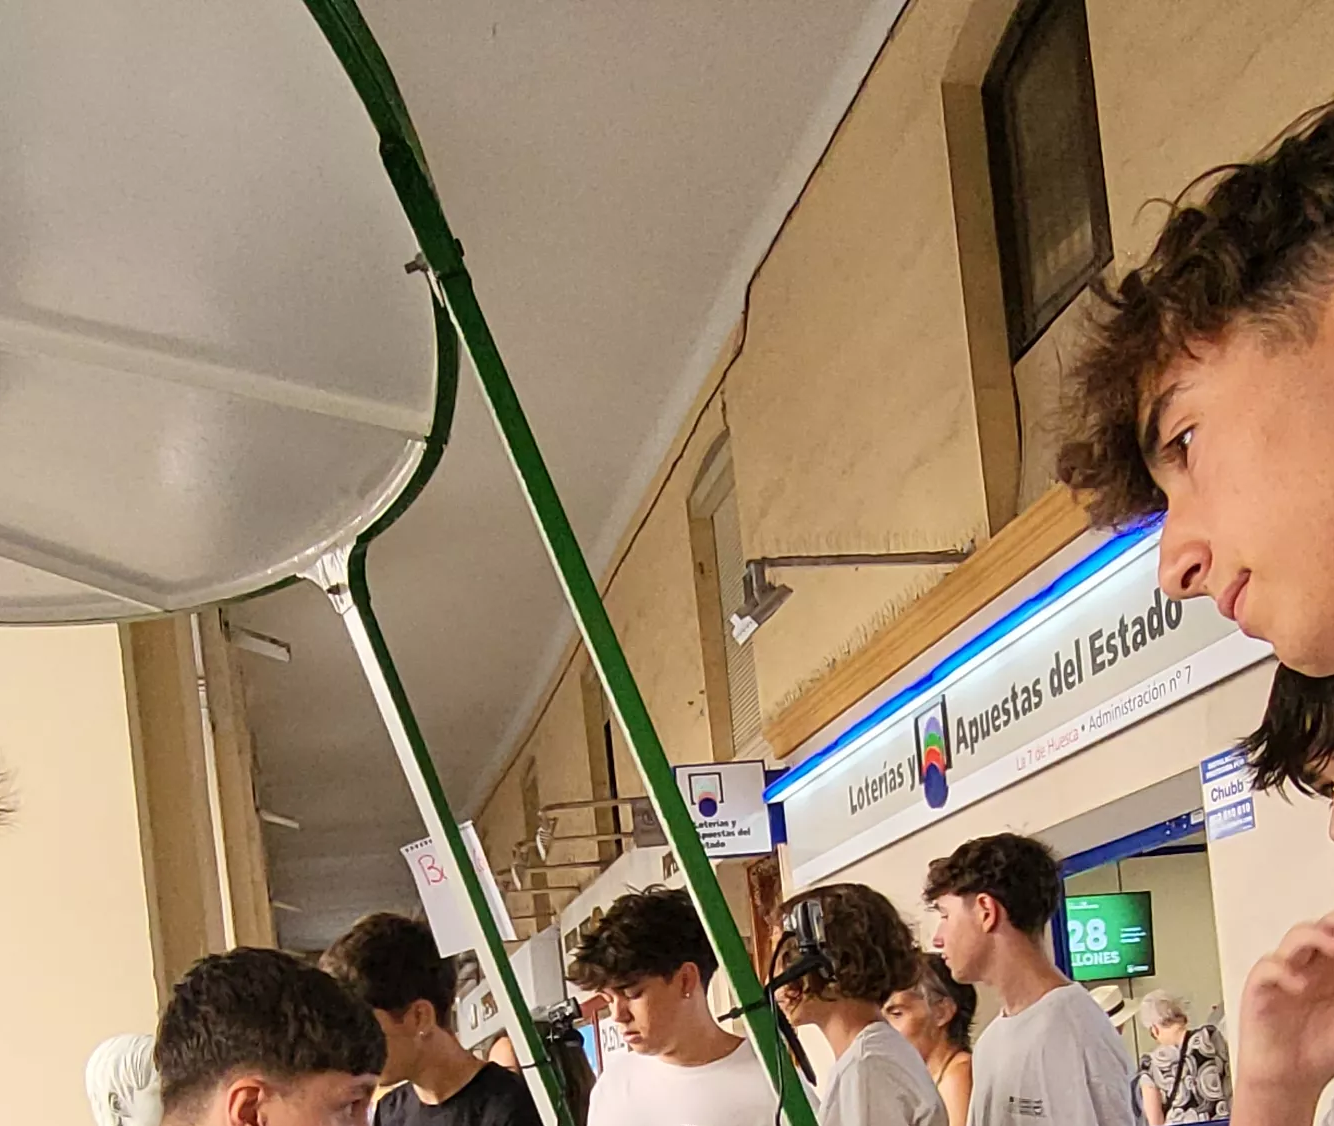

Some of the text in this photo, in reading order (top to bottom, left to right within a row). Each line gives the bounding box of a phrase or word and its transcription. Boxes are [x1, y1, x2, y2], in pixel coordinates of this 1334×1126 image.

[849, 587, 1183, 815] Loterías y Apuestas del Estado
[1017, 757, 1026, 771] La
[1027, 750, 1033, 764] 7
[1035, 746, 1046, 761] de
[1047, 727, 1079, 755] Huesca
[1089, 681, 1167, 732] Administración
[1185, 665, 1192, 684] 7
[1211, 779, 1244, 802] Chubb
[1067, 919, 1108, 952] 28
[1071, 951, 1121, 967] LONES
